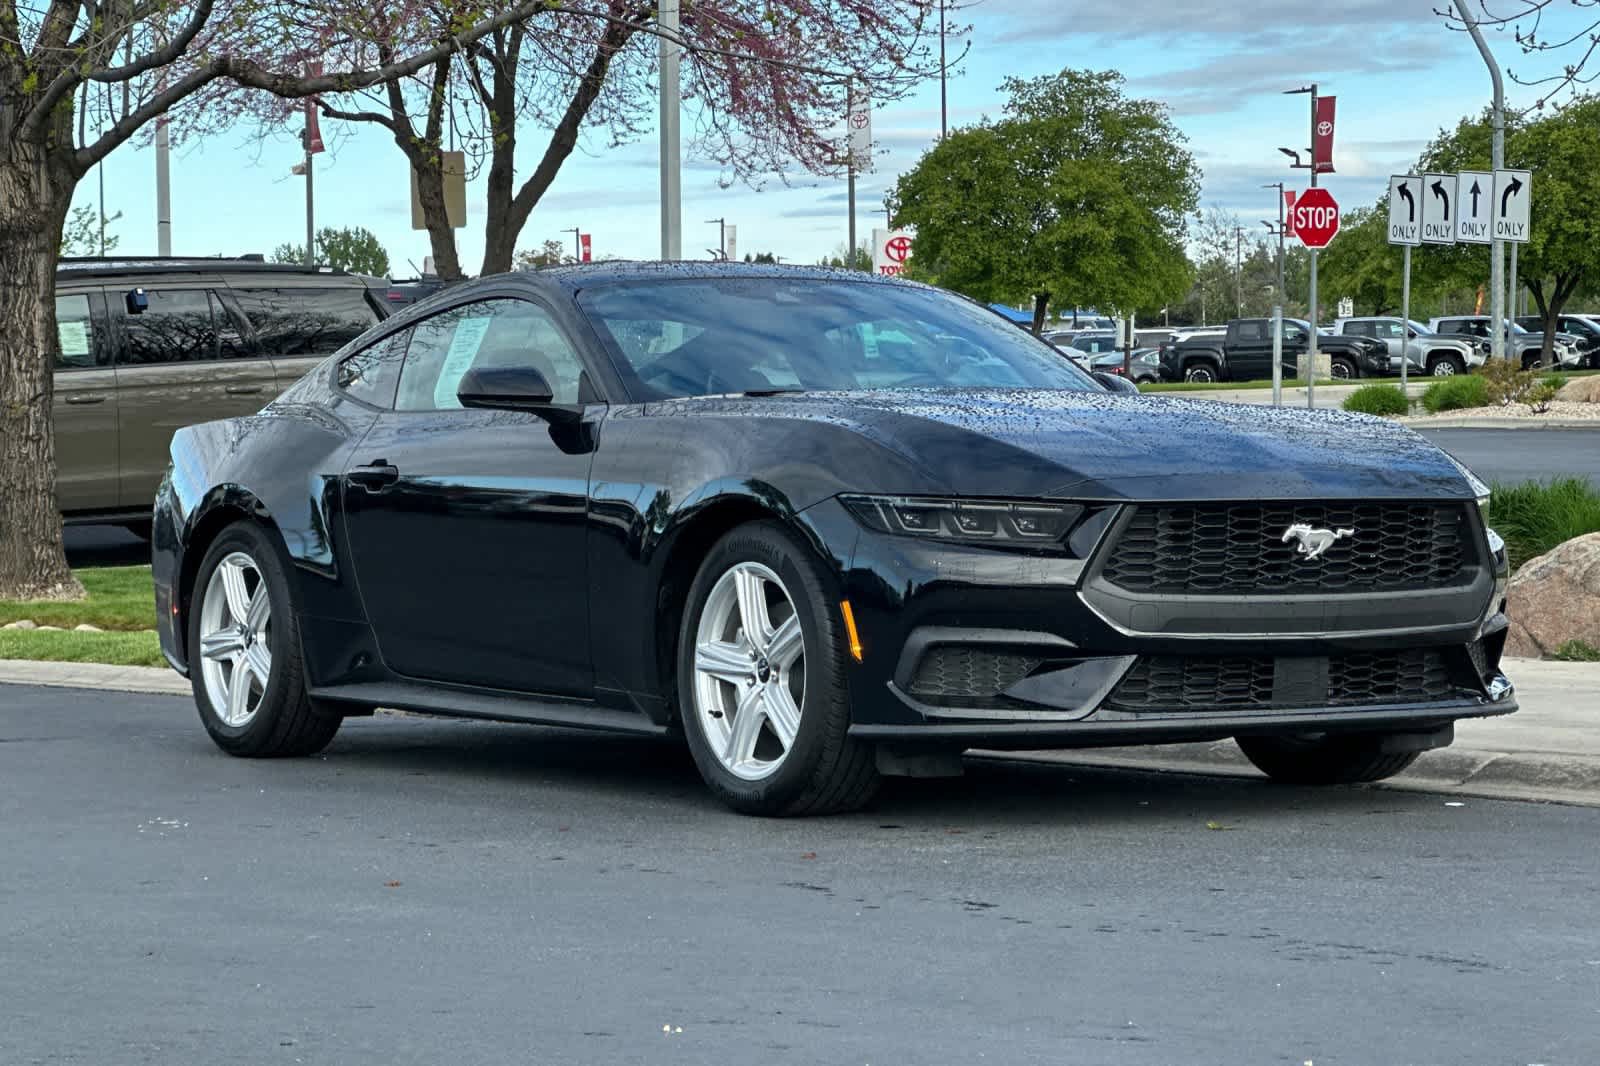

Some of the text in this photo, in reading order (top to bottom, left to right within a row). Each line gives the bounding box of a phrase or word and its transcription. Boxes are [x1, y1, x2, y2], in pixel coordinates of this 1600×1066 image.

[1296, 206, 1337, 229] STOP
[1392, 224, 1417, 239] ONLY
[1425, 223, 1451, 238] ONLY
[1461, 222, 1487, 237] ONLY
[1497, 221, 1525, 237] ONLY
